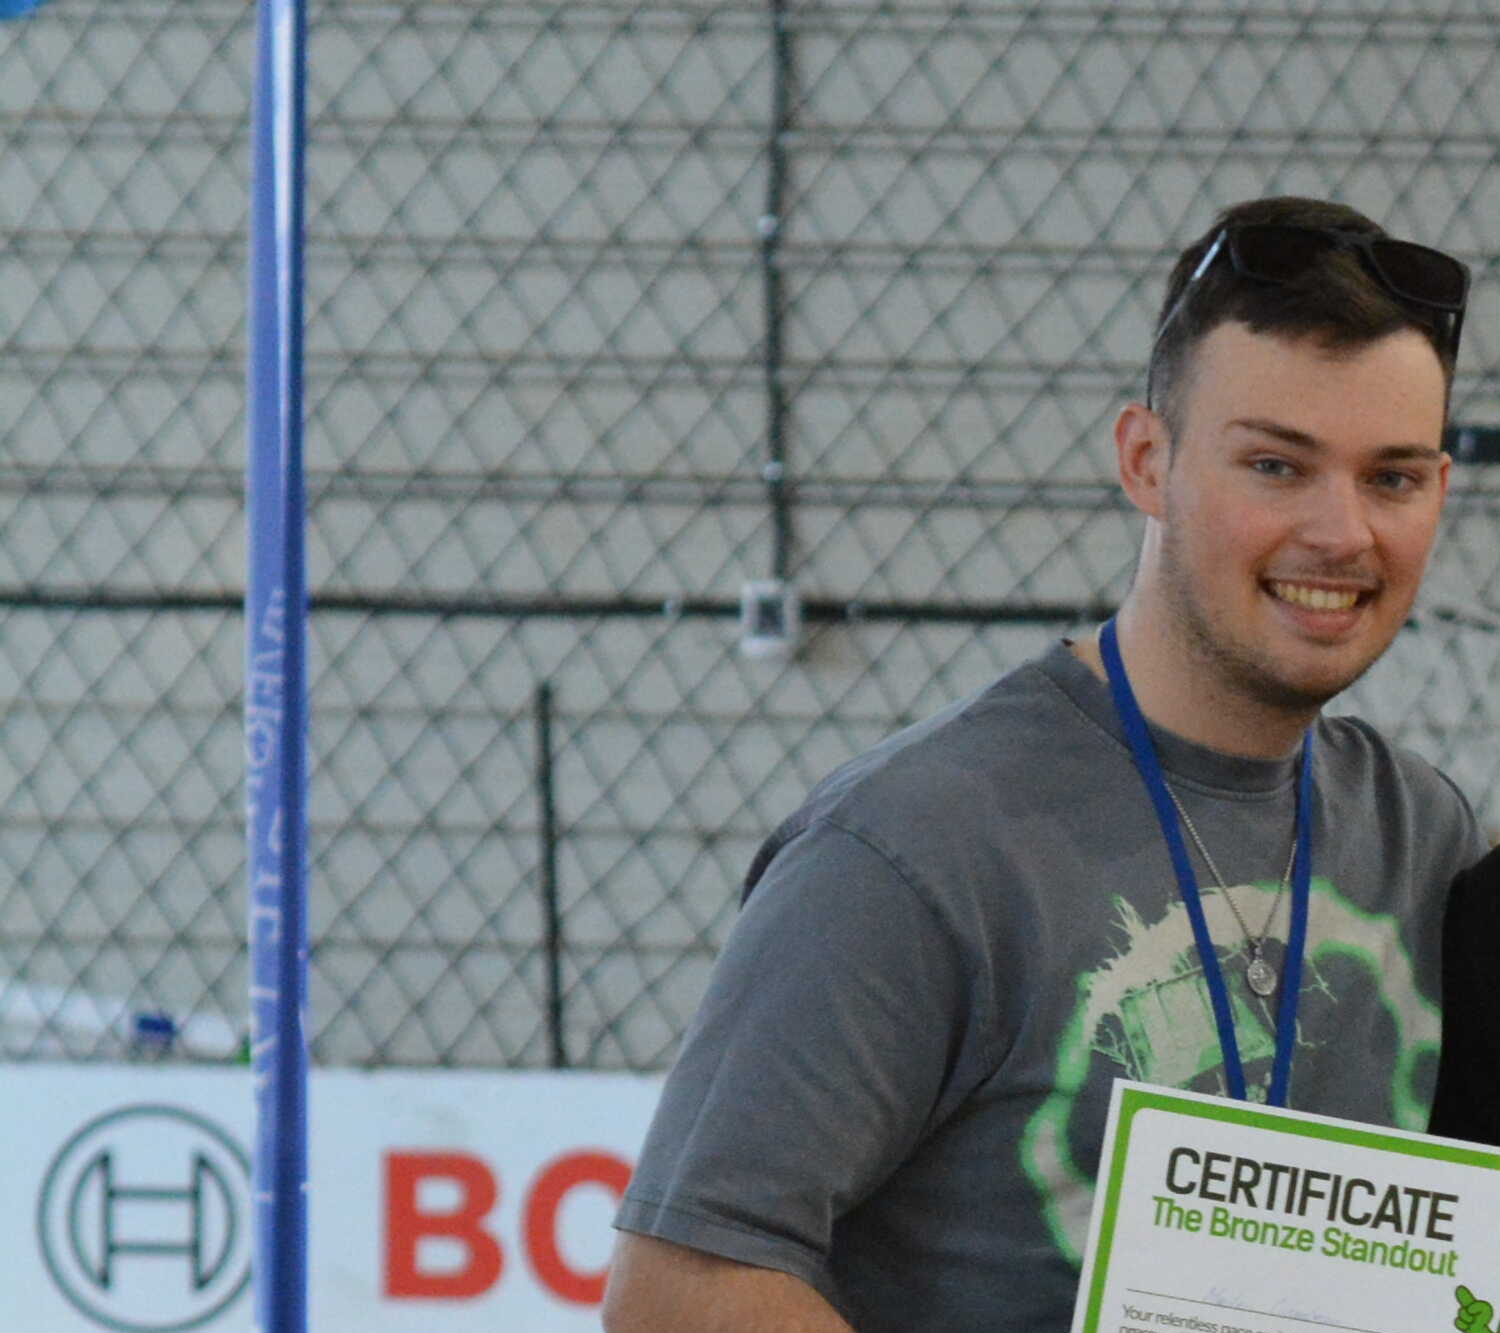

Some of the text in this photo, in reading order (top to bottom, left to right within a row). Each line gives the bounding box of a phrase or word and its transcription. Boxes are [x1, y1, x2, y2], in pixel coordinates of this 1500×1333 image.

[1166, 1147, 1458, 1240] CERTIFICATE
[1152, 1195, 1458, 1277] The Bronze Standout
[1121, 1303, 1152, 1322] Your
[1154, 1312, 1219, 1333] relentless
